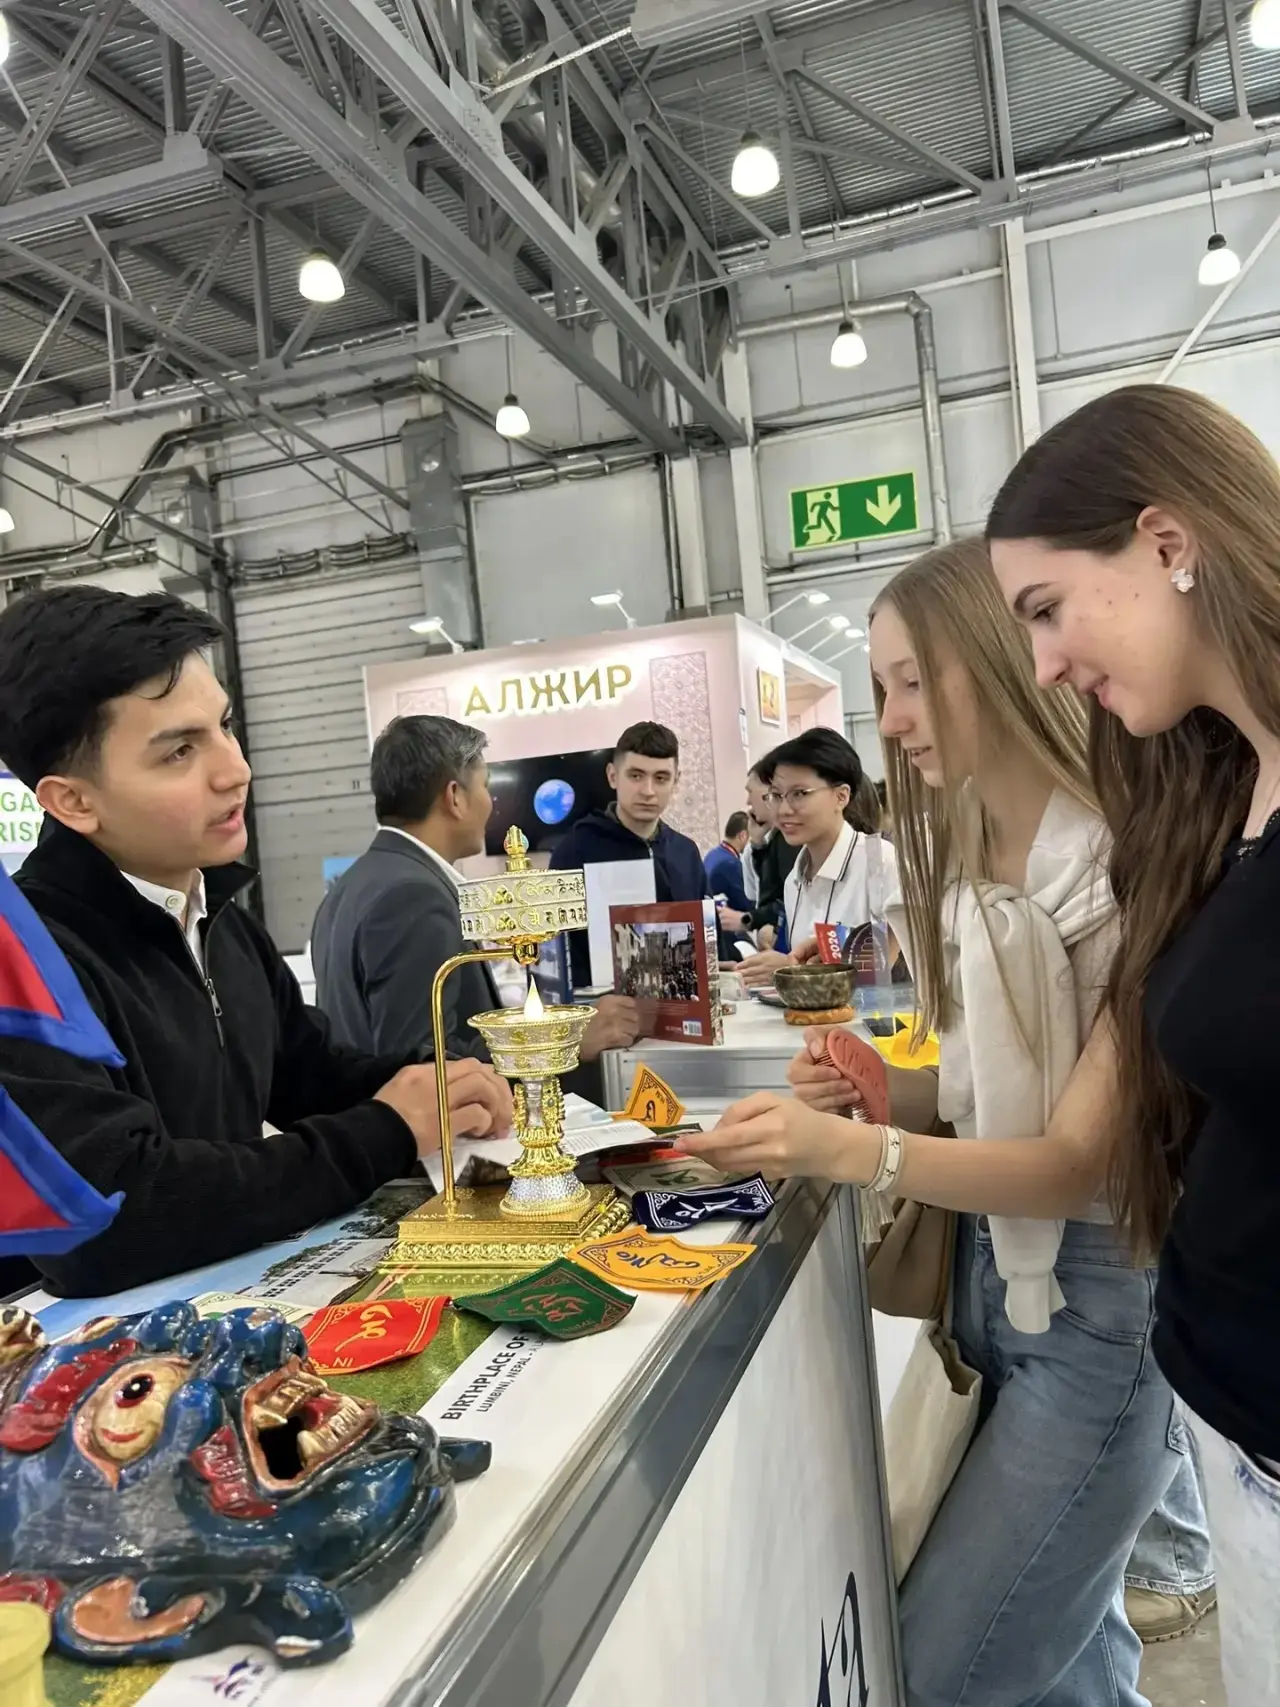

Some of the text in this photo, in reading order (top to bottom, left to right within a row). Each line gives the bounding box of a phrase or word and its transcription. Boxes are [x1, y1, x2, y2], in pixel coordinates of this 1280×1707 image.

[464, 664, 632, 717] АЛЖИР
[1, 791, 41, 812] GA
[826, 930, 842, 960] 2026
[440, 1335, 530, 1420] BIRTHPLACE OF
[476, 1379, 516, 1412] LUMBINI,
[505, 1357, 531, 1379] NEPAL
